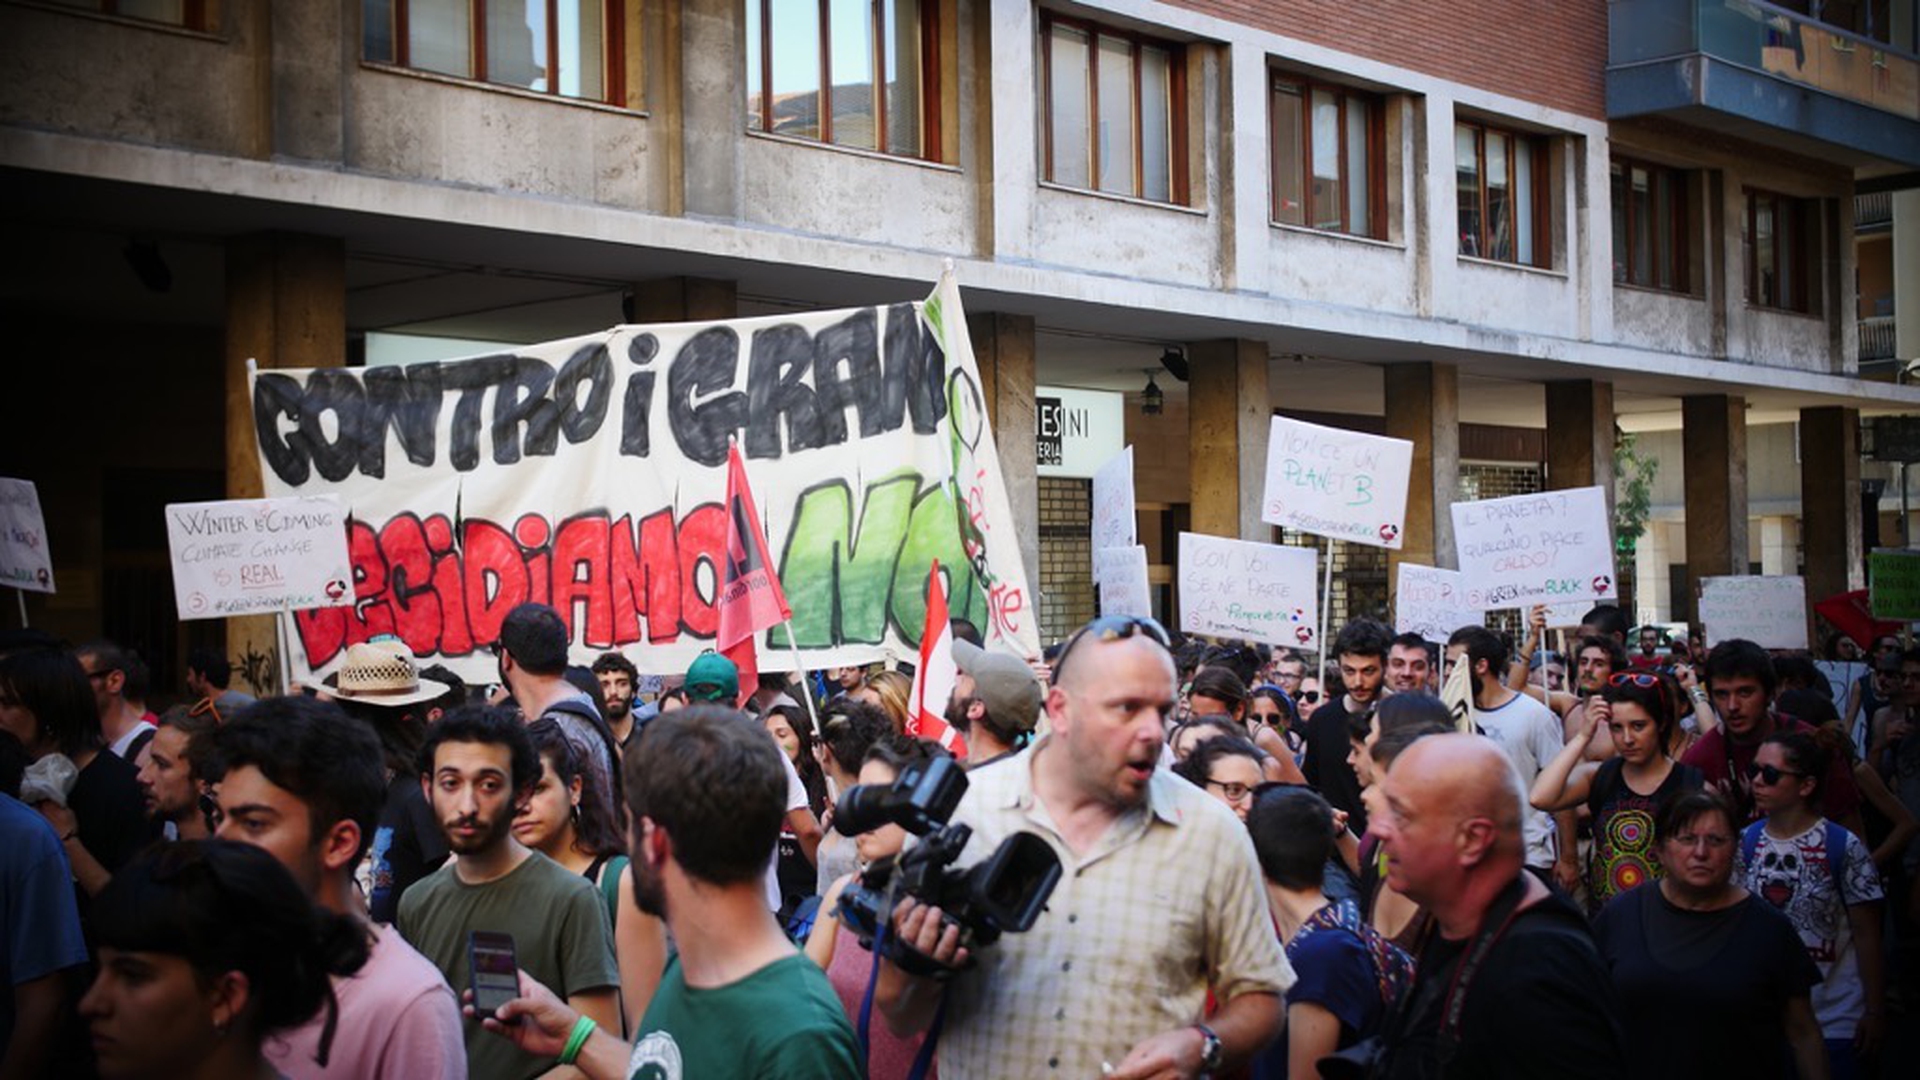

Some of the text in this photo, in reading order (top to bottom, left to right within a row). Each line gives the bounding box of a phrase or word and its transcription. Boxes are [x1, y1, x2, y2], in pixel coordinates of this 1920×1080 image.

[253, 342, 613, 486] CONTRO
[1282, 457, 1374, 507] PLANET B
[175, 509, 248, 536] WINTER
[266, 509, 333, 533] COMING
[181, 540, 243, 564] CLIMATE
[240, 564, 284, 587] REAL
